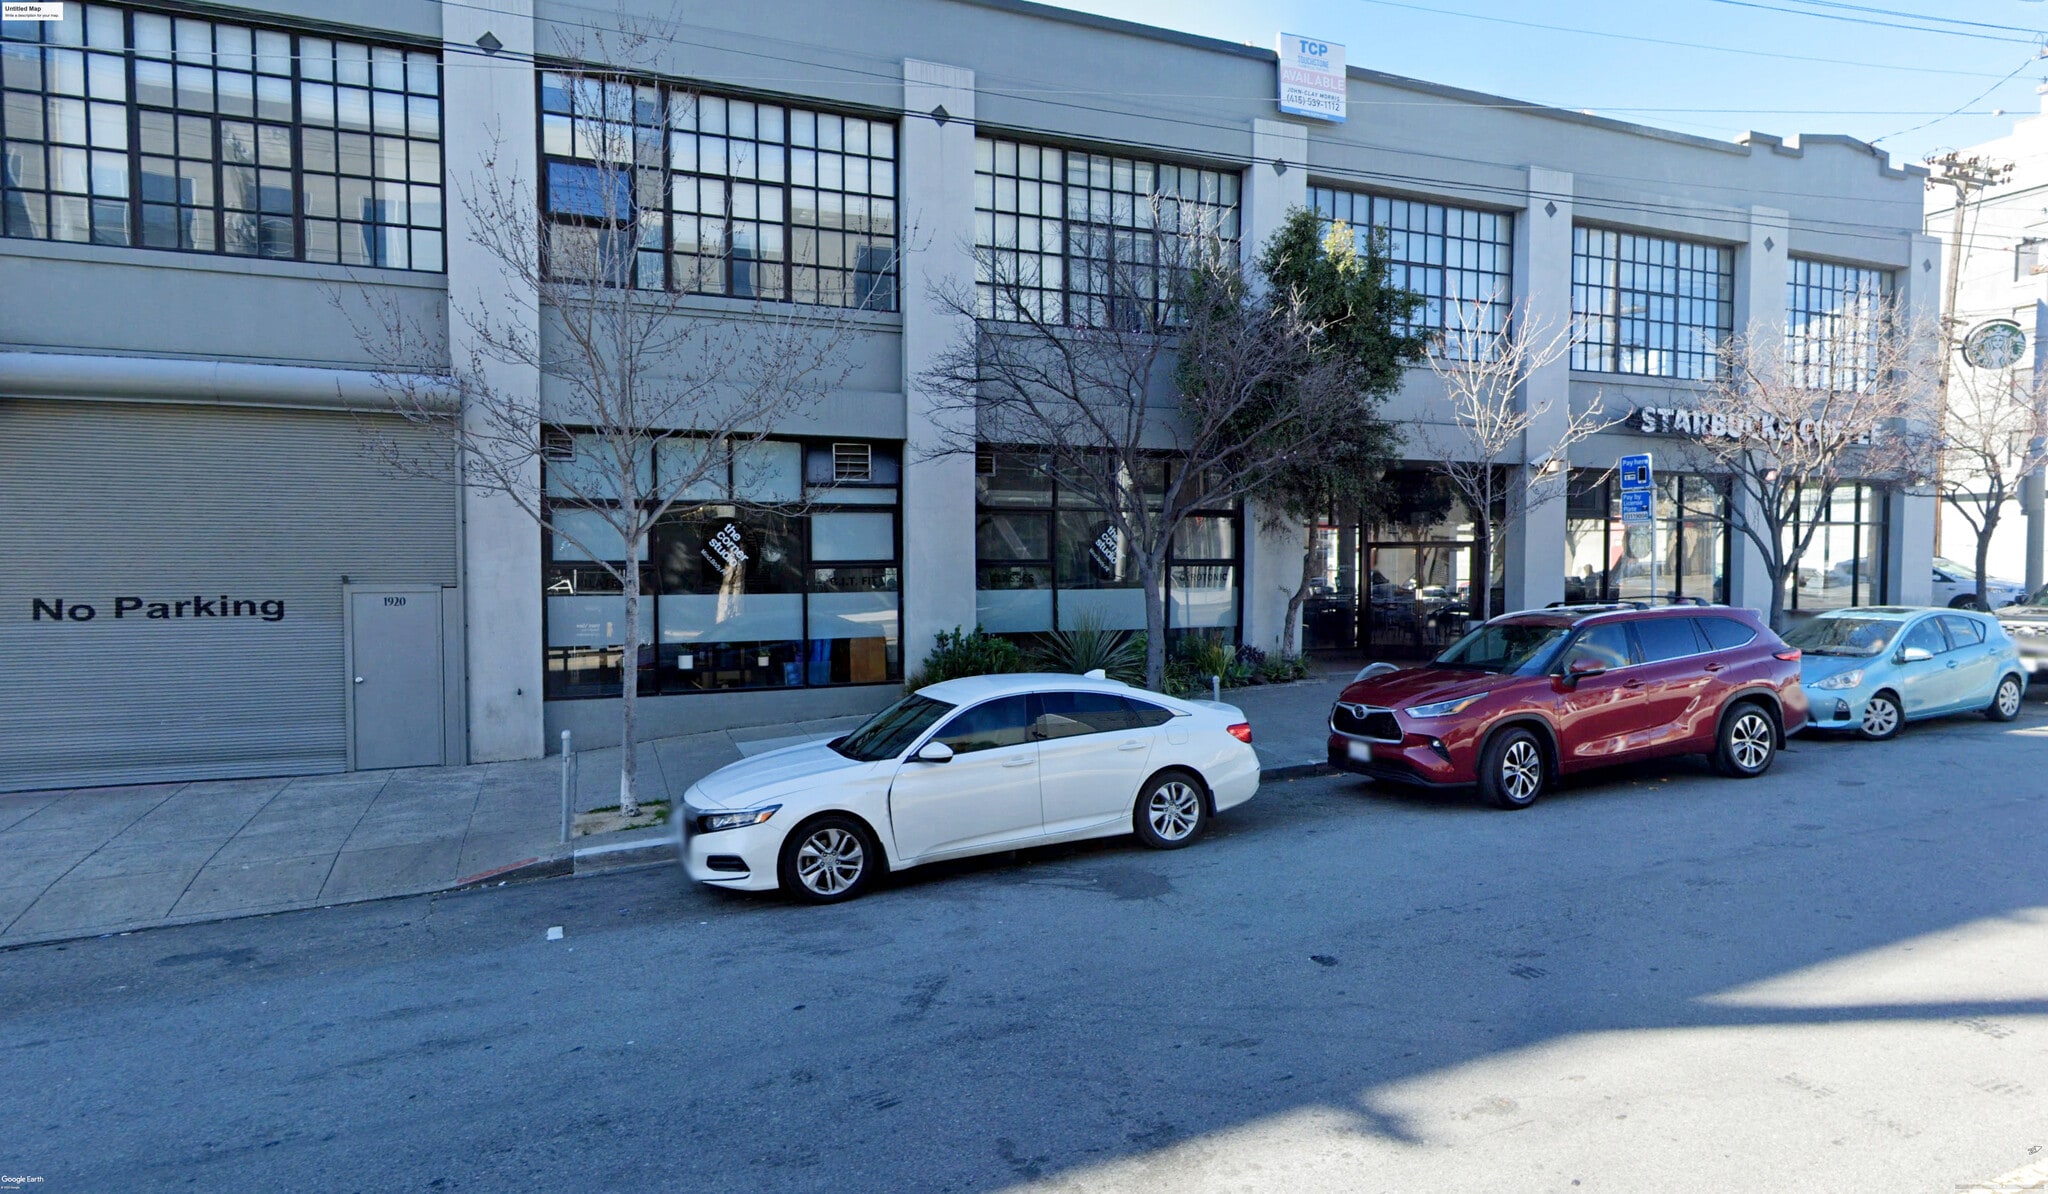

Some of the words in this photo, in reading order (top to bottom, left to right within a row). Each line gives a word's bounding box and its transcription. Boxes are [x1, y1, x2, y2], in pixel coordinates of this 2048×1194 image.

[1300, 40, 1328, 56] TCP
[1282, 69, 1344, 91] AVAILABLE
[1286, 93, 1306, 106] (415)
[1287, 87, 1318, 97] JOHN-CLAY
[1319, 93, 1340, 102] MORRIS
[1799, 418, 1883, 446] COEE
[724, 523, 741, 541] the
[709, 538, 738, 567] studio
[717, 531, 749, 561] corner
[1095, 538, 1117, 564] studio
[32, 598, 96, 621] No
[114, 595, 285, 621] Parking
[384, 596, 406, 607] 1920
